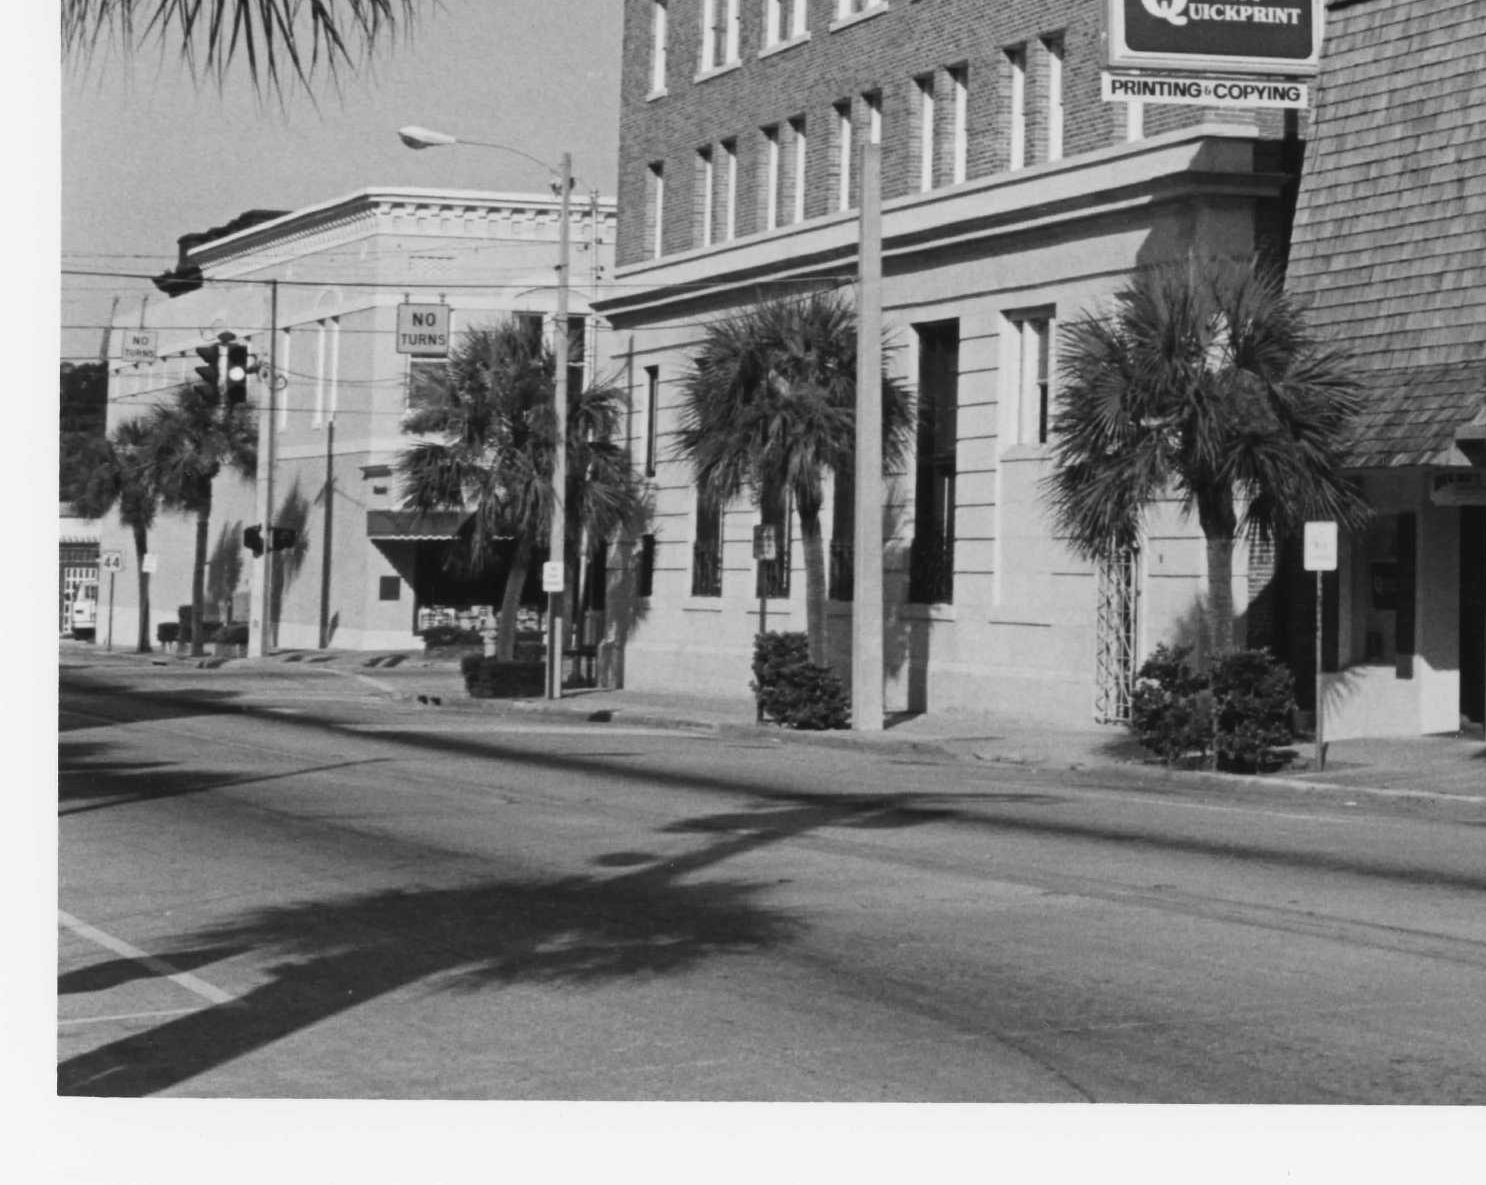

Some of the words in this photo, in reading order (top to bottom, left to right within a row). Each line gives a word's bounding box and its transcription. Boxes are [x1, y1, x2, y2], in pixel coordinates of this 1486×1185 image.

[1110, 79, 1202, 98] PRINTING
[1203, 85, 1212, 97] &
[1212, 82, 1301, 102] COPYING
[412, 312, 436, 327] NO
[132, 335, 149, 345] NO
[401, 333, 447, 346] TURNS
[104, 557, 120, 568] 44
